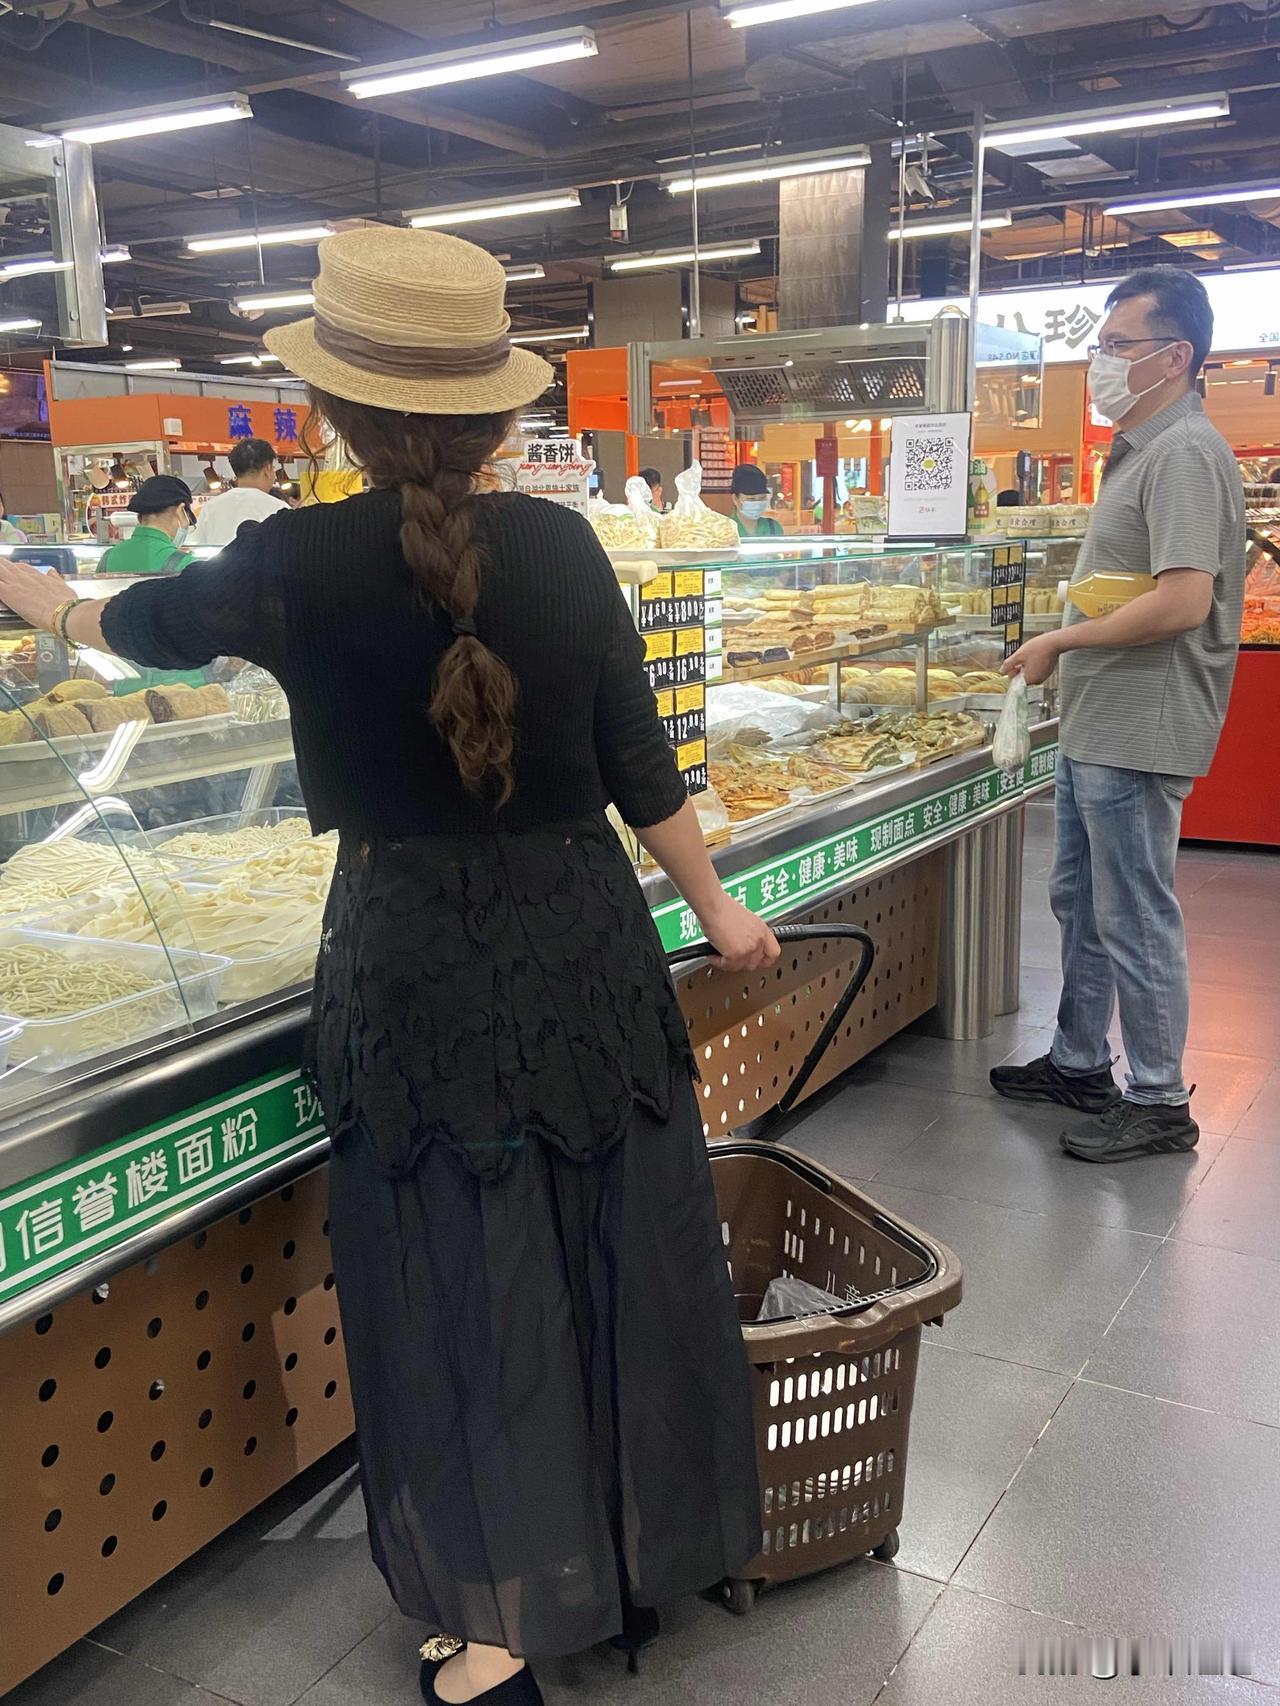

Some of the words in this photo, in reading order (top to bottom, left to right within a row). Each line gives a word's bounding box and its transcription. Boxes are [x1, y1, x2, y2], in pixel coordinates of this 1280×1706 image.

[527, 443, 574, 463] 酱香饼
[870, 812, 915, 851] 现制面点
[0, 1108, 257, 1273] 信誉楼面粉
